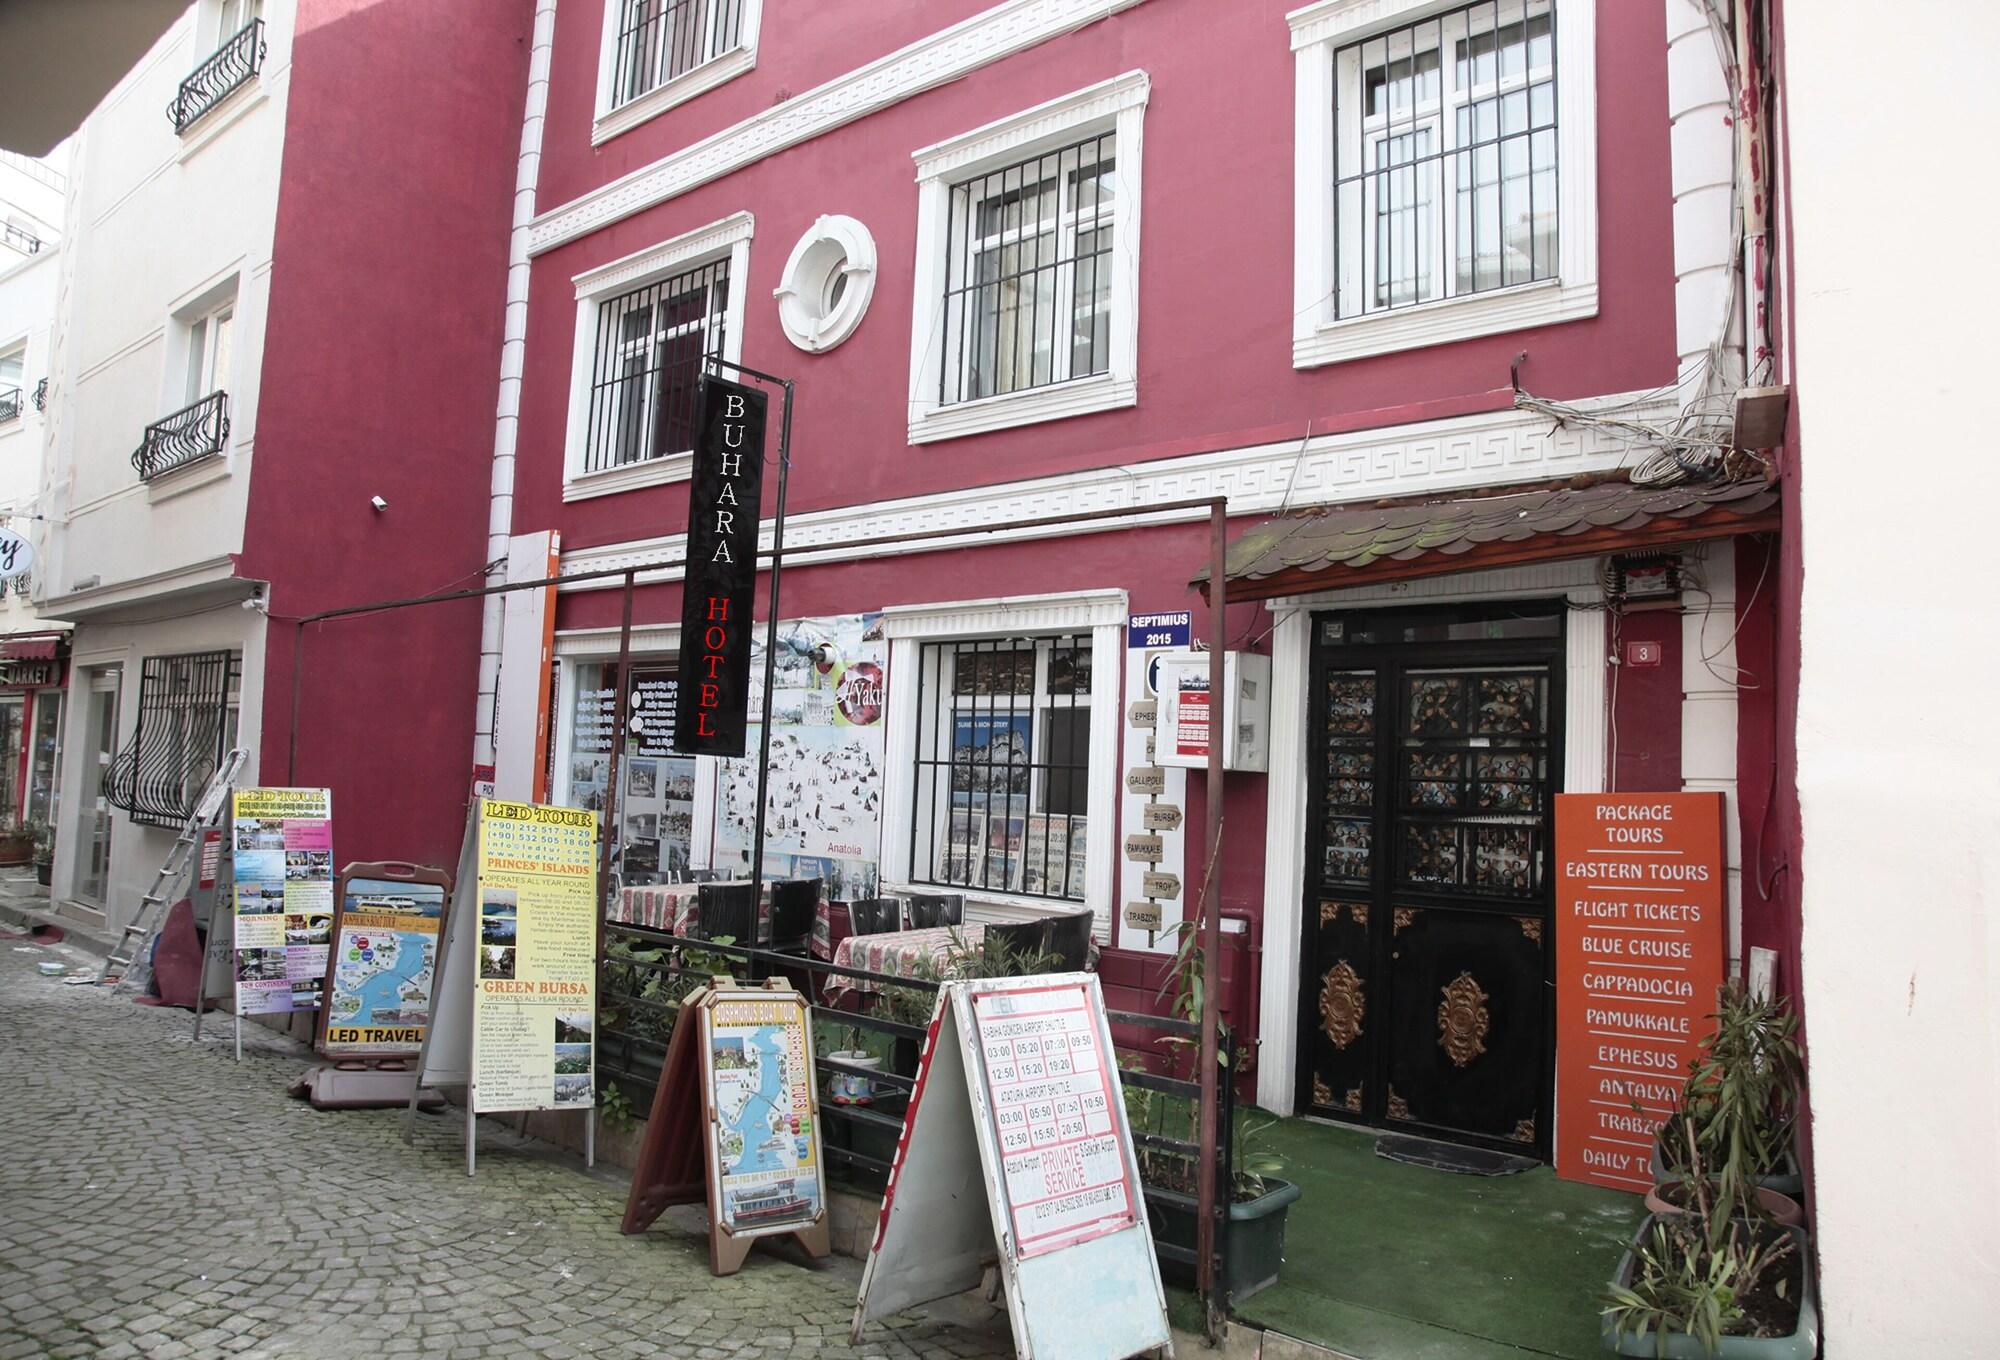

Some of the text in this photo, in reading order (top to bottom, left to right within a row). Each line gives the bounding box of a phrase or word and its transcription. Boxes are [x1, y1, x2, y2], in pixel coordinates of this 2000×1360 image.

[696, 394, 745, 737] BUHARA HOTEL
[1131, 614, 1188, 628] SEPTIMIUS
[1146, 633, 1172, 645] 2015
[1639, 647, 1648, 660] 3
[487, 802, 592, 827] LED TOUR
[1153, 812, 1176, 821] BURSA
[1596, 804, 1673, 820] PACKAGE
[520, 823, 538, 832] 212
[541, 826, 560, 834] 517
[564, 828, 575, 836] 34
[1606, 827, 1664, 843] TOURS
[519, 833, 538, 842] 532
[564, 838, 575, 846] 18
[827, 842, 862, 855] Anatolia
[542, 862, 590, 875] ISLANDS
[1566, 862, 1709, 881] EASTERN TOURS
[485, 874, 590, 889] OPERATES ALL YEAR ROUND
[1155, 881, 1172, 891] TROY
[239, 915, 279, 923] MORNING
[1129, 911, 1158, 922] TRABZON
[1574, 901, 1701, 921] FLIGHT TICKETS
[1582, 936, 1693, 958] BLUE CRUISE
[483, 980, 589, 995] GREEN BURSA
[1583, 973, 1693, 997] CAPPADOCIA
[1586, 1008, 1690, 1034] PAMUKKALE
[329, 1029, 423, 1042] LED TRAVEL
[987, 1034, 1092, 1058] 03:00 05:20 07:20 09:50
[1598, 1046, 1678, 1069] EPHESUS
[992, 1058, 1070, 1080] 12:50 15:20 19:20
[1600, 1078, 1677, 1102] ANTALYA
[1000, 1095, 1104, 1125] 03:00 05:50 07:50 10:50
[1004, 1121, 1083, 1147] 12:50 15:50 20:50
[1041, 1145, 1082, 1173] PRIVATE
[1583, 1148, 1630, 1170] DAILY
[1044, 1166, 1086, 1195] SERVICE
